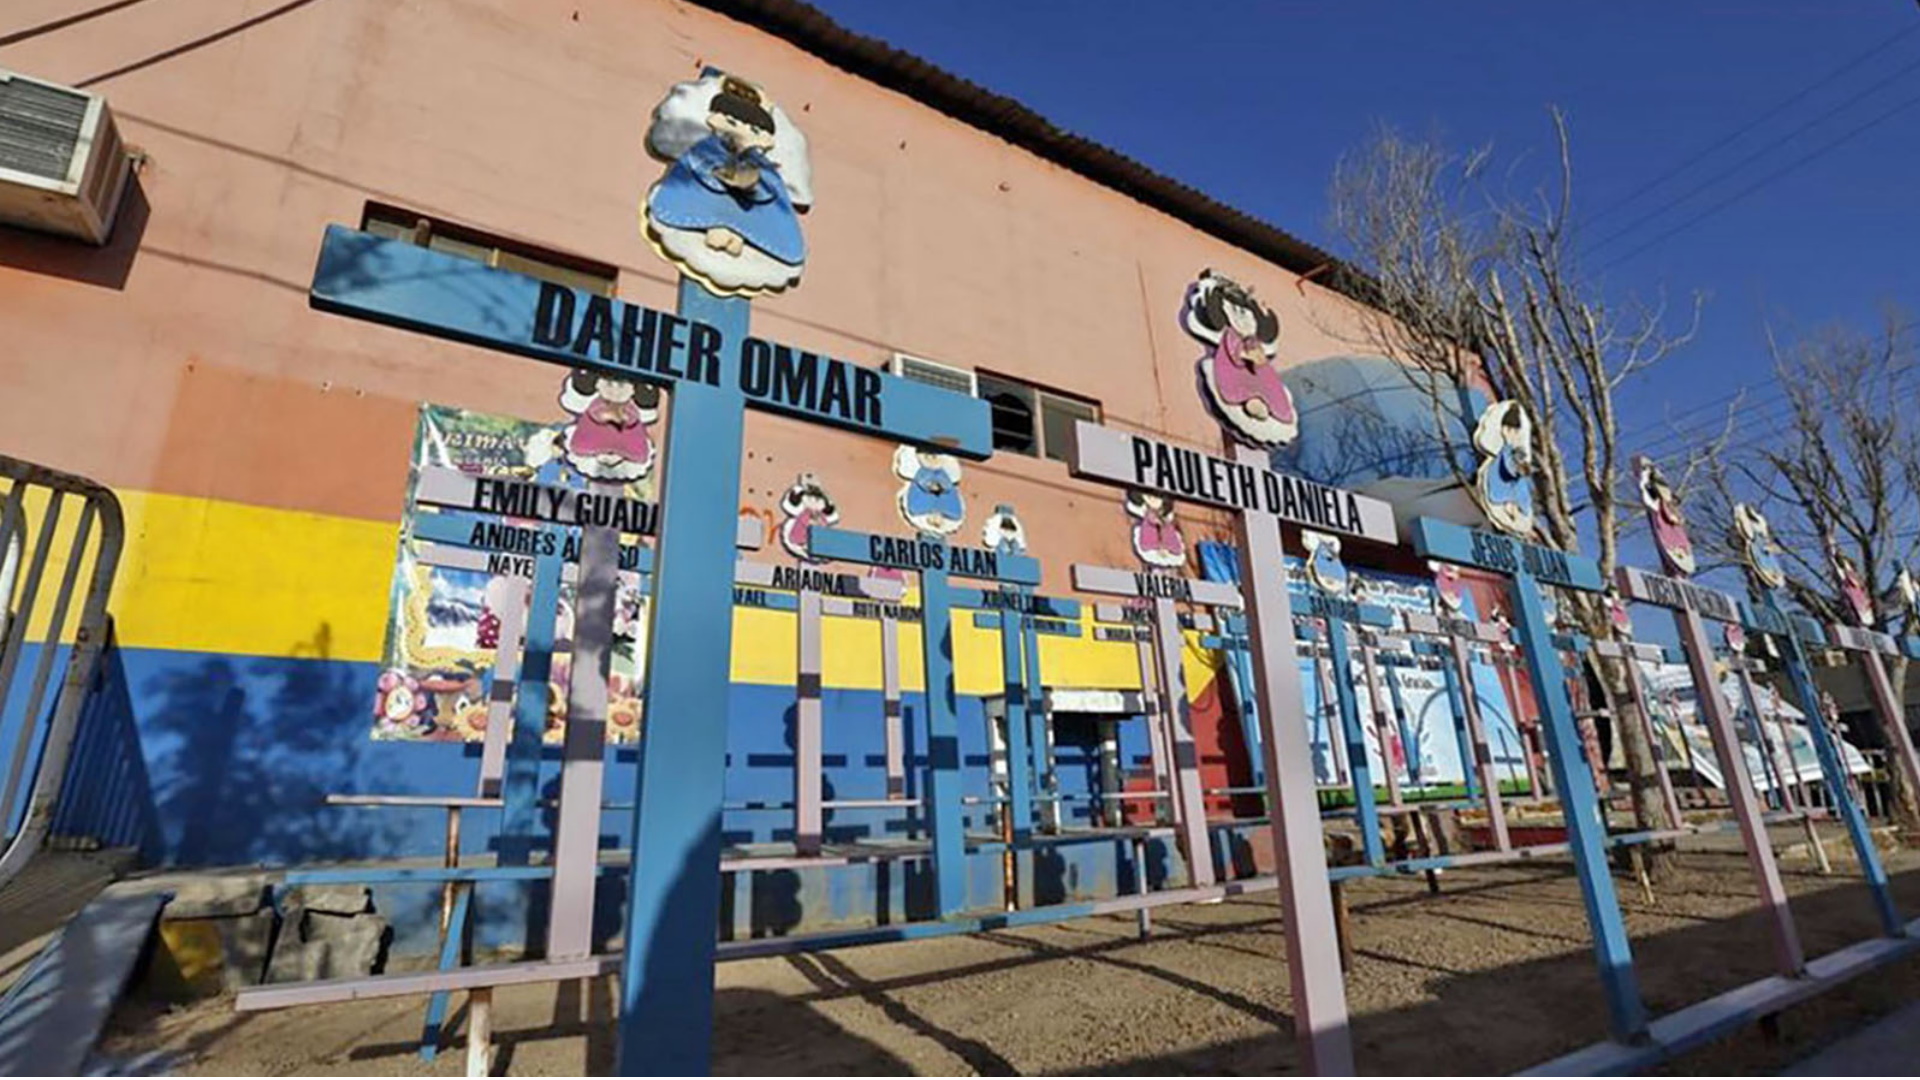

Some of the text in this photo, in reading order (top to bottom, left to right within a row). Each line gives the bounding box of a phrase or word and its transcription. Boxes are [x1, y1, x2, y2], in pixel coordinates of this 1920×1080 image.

[532, 281, 882, 427] DAHER OMAR
[472, 478, 570, 522] EMILY
[1132, 436, 1366, 535] PAULETH DANIELA
[470, 520, 557, 557] ANDRES
[869, 534, 998, 577] CARLOS ALAN
[1471, 531, 1519, 573] JESUS
[486, 554, 534, 580] NAYE
[772, 565, 845, 596] ARIADNA
[1134, 572, 1193, 602] VALERIA
